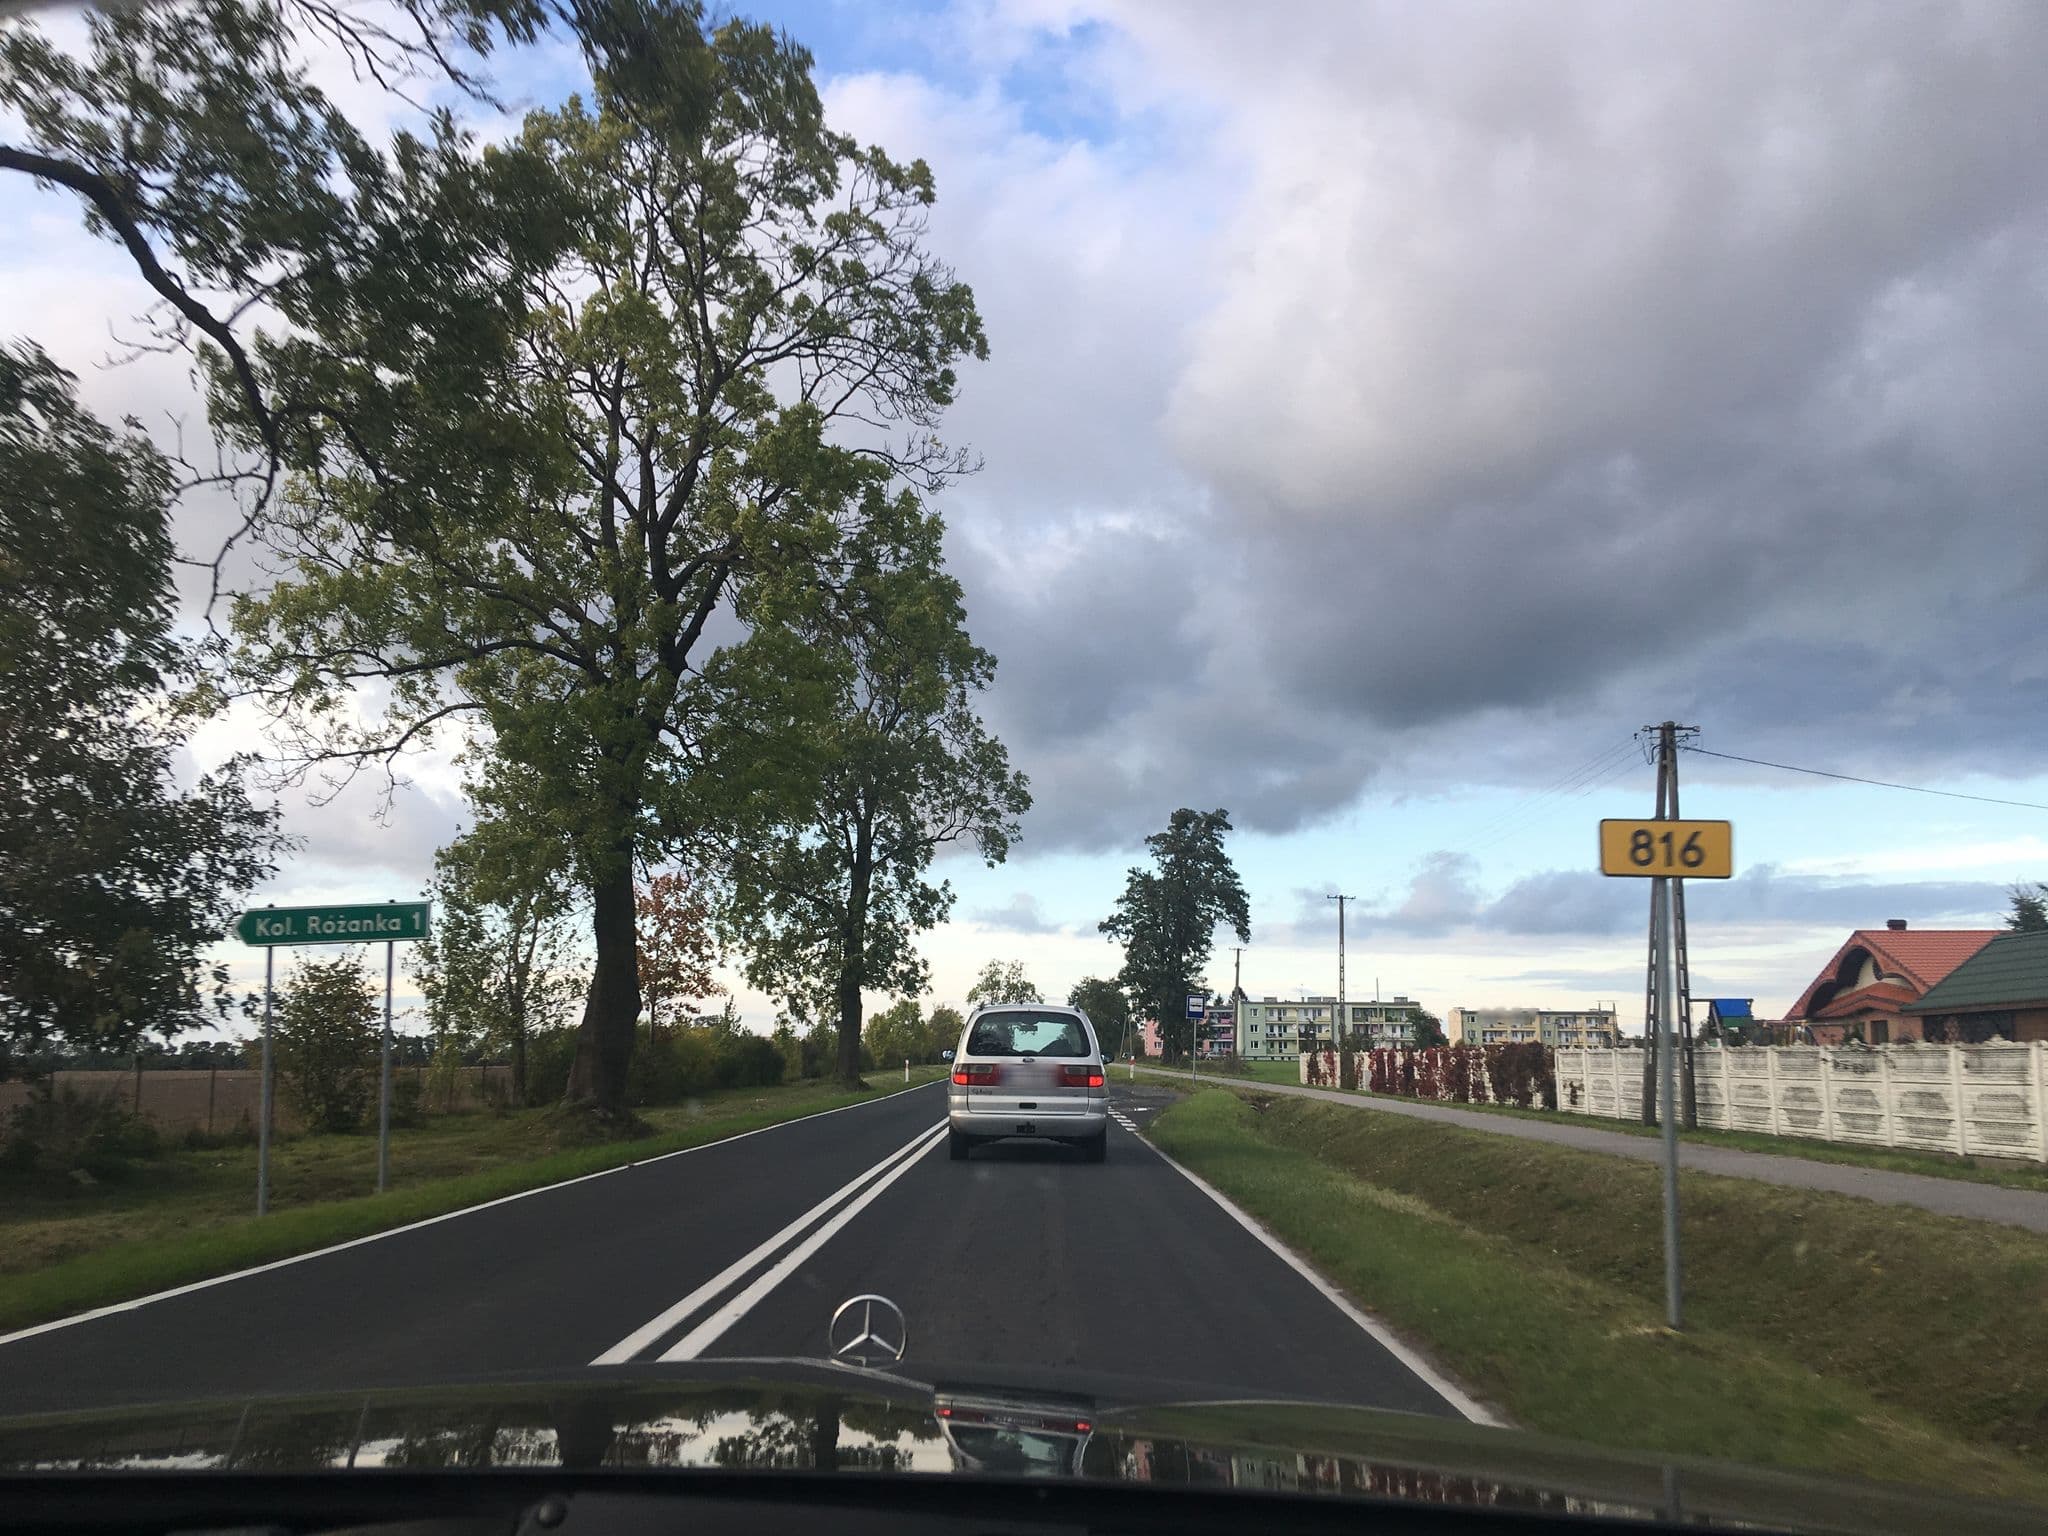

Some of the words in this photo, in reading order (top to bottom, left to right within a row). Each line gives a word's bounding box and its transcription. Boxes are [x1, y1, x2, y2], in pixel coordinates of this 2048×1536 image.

[1630, 830, 1705, 867] 816
[256, 917, 298, 936] Kol.
[307, 912, 401, 935] Różanka
[413, 911, 421, 931] 1
